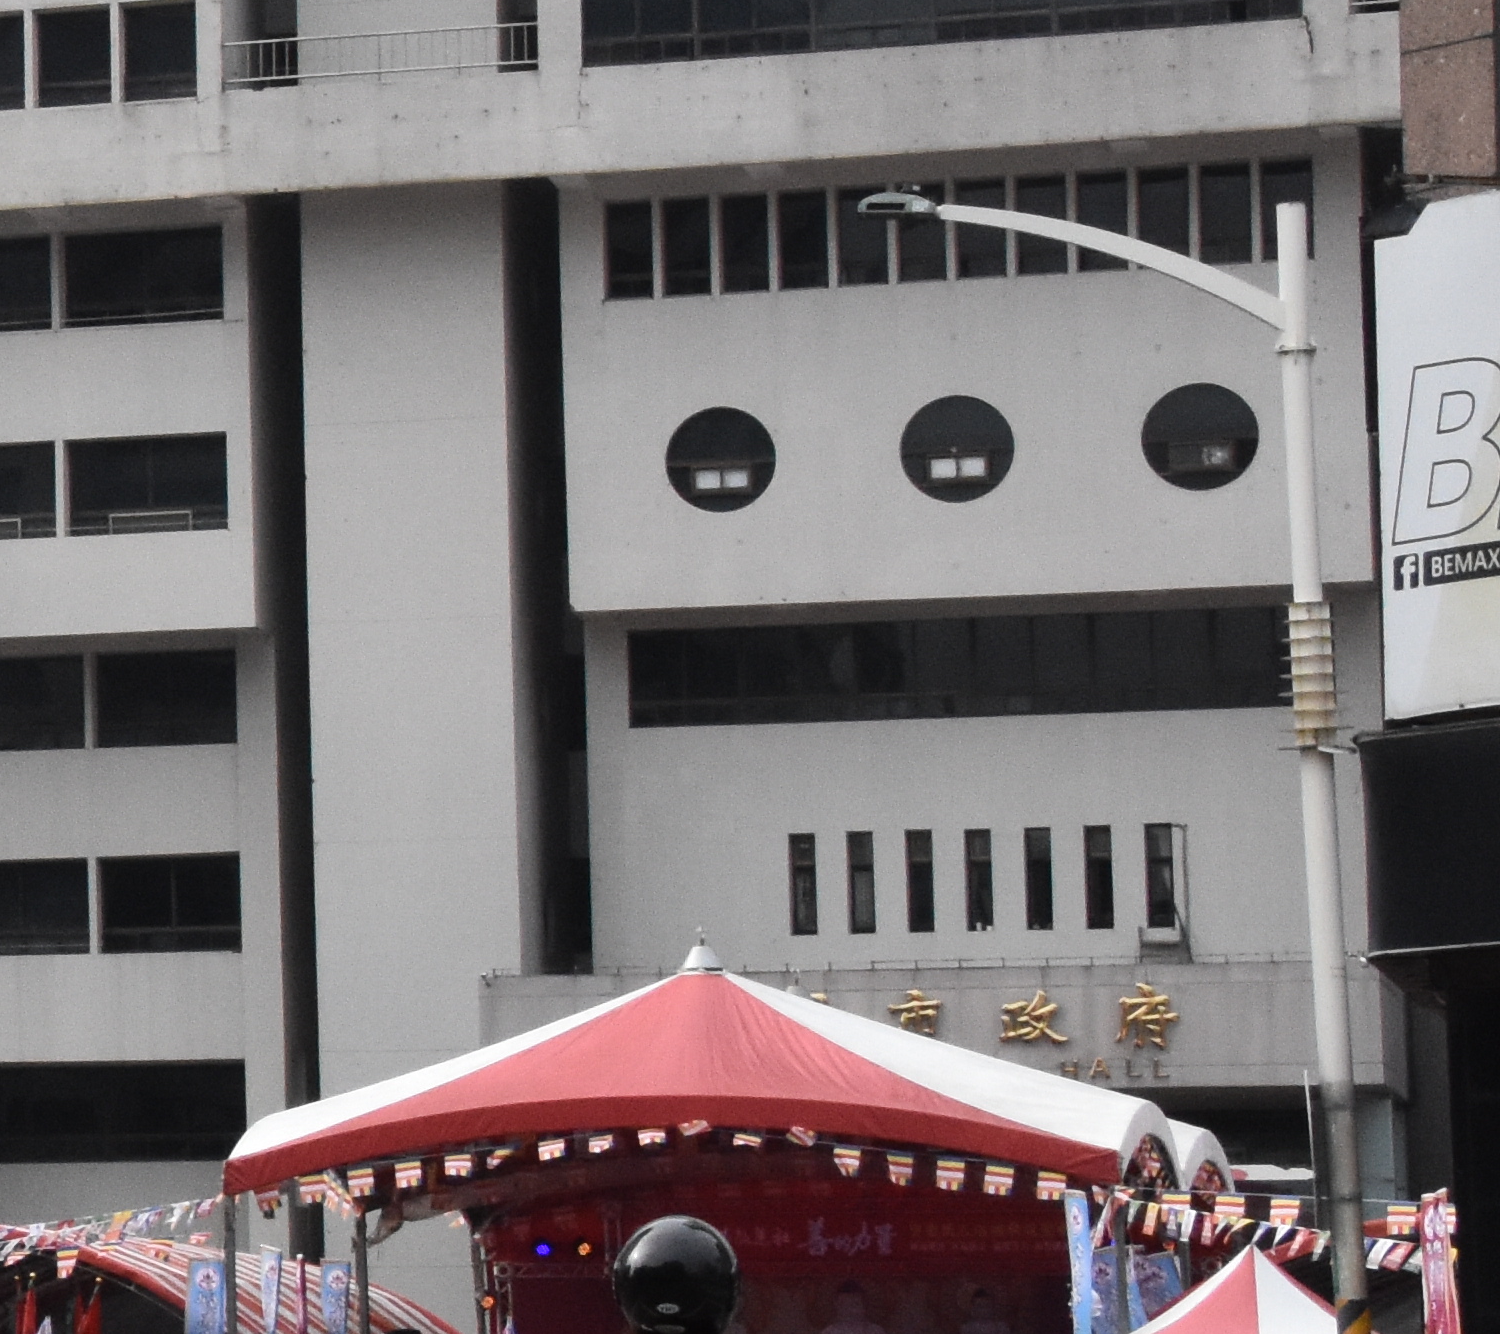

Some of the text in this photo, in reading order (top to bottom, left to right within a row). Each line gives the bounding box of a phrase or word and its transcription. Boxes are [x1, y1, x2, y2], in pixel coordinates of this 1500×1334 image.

[1392, 356, 1500, 547] B
[810, 982, 1180, 1050] 市政府
[1060, 1056, 1171, 1080] HALL
